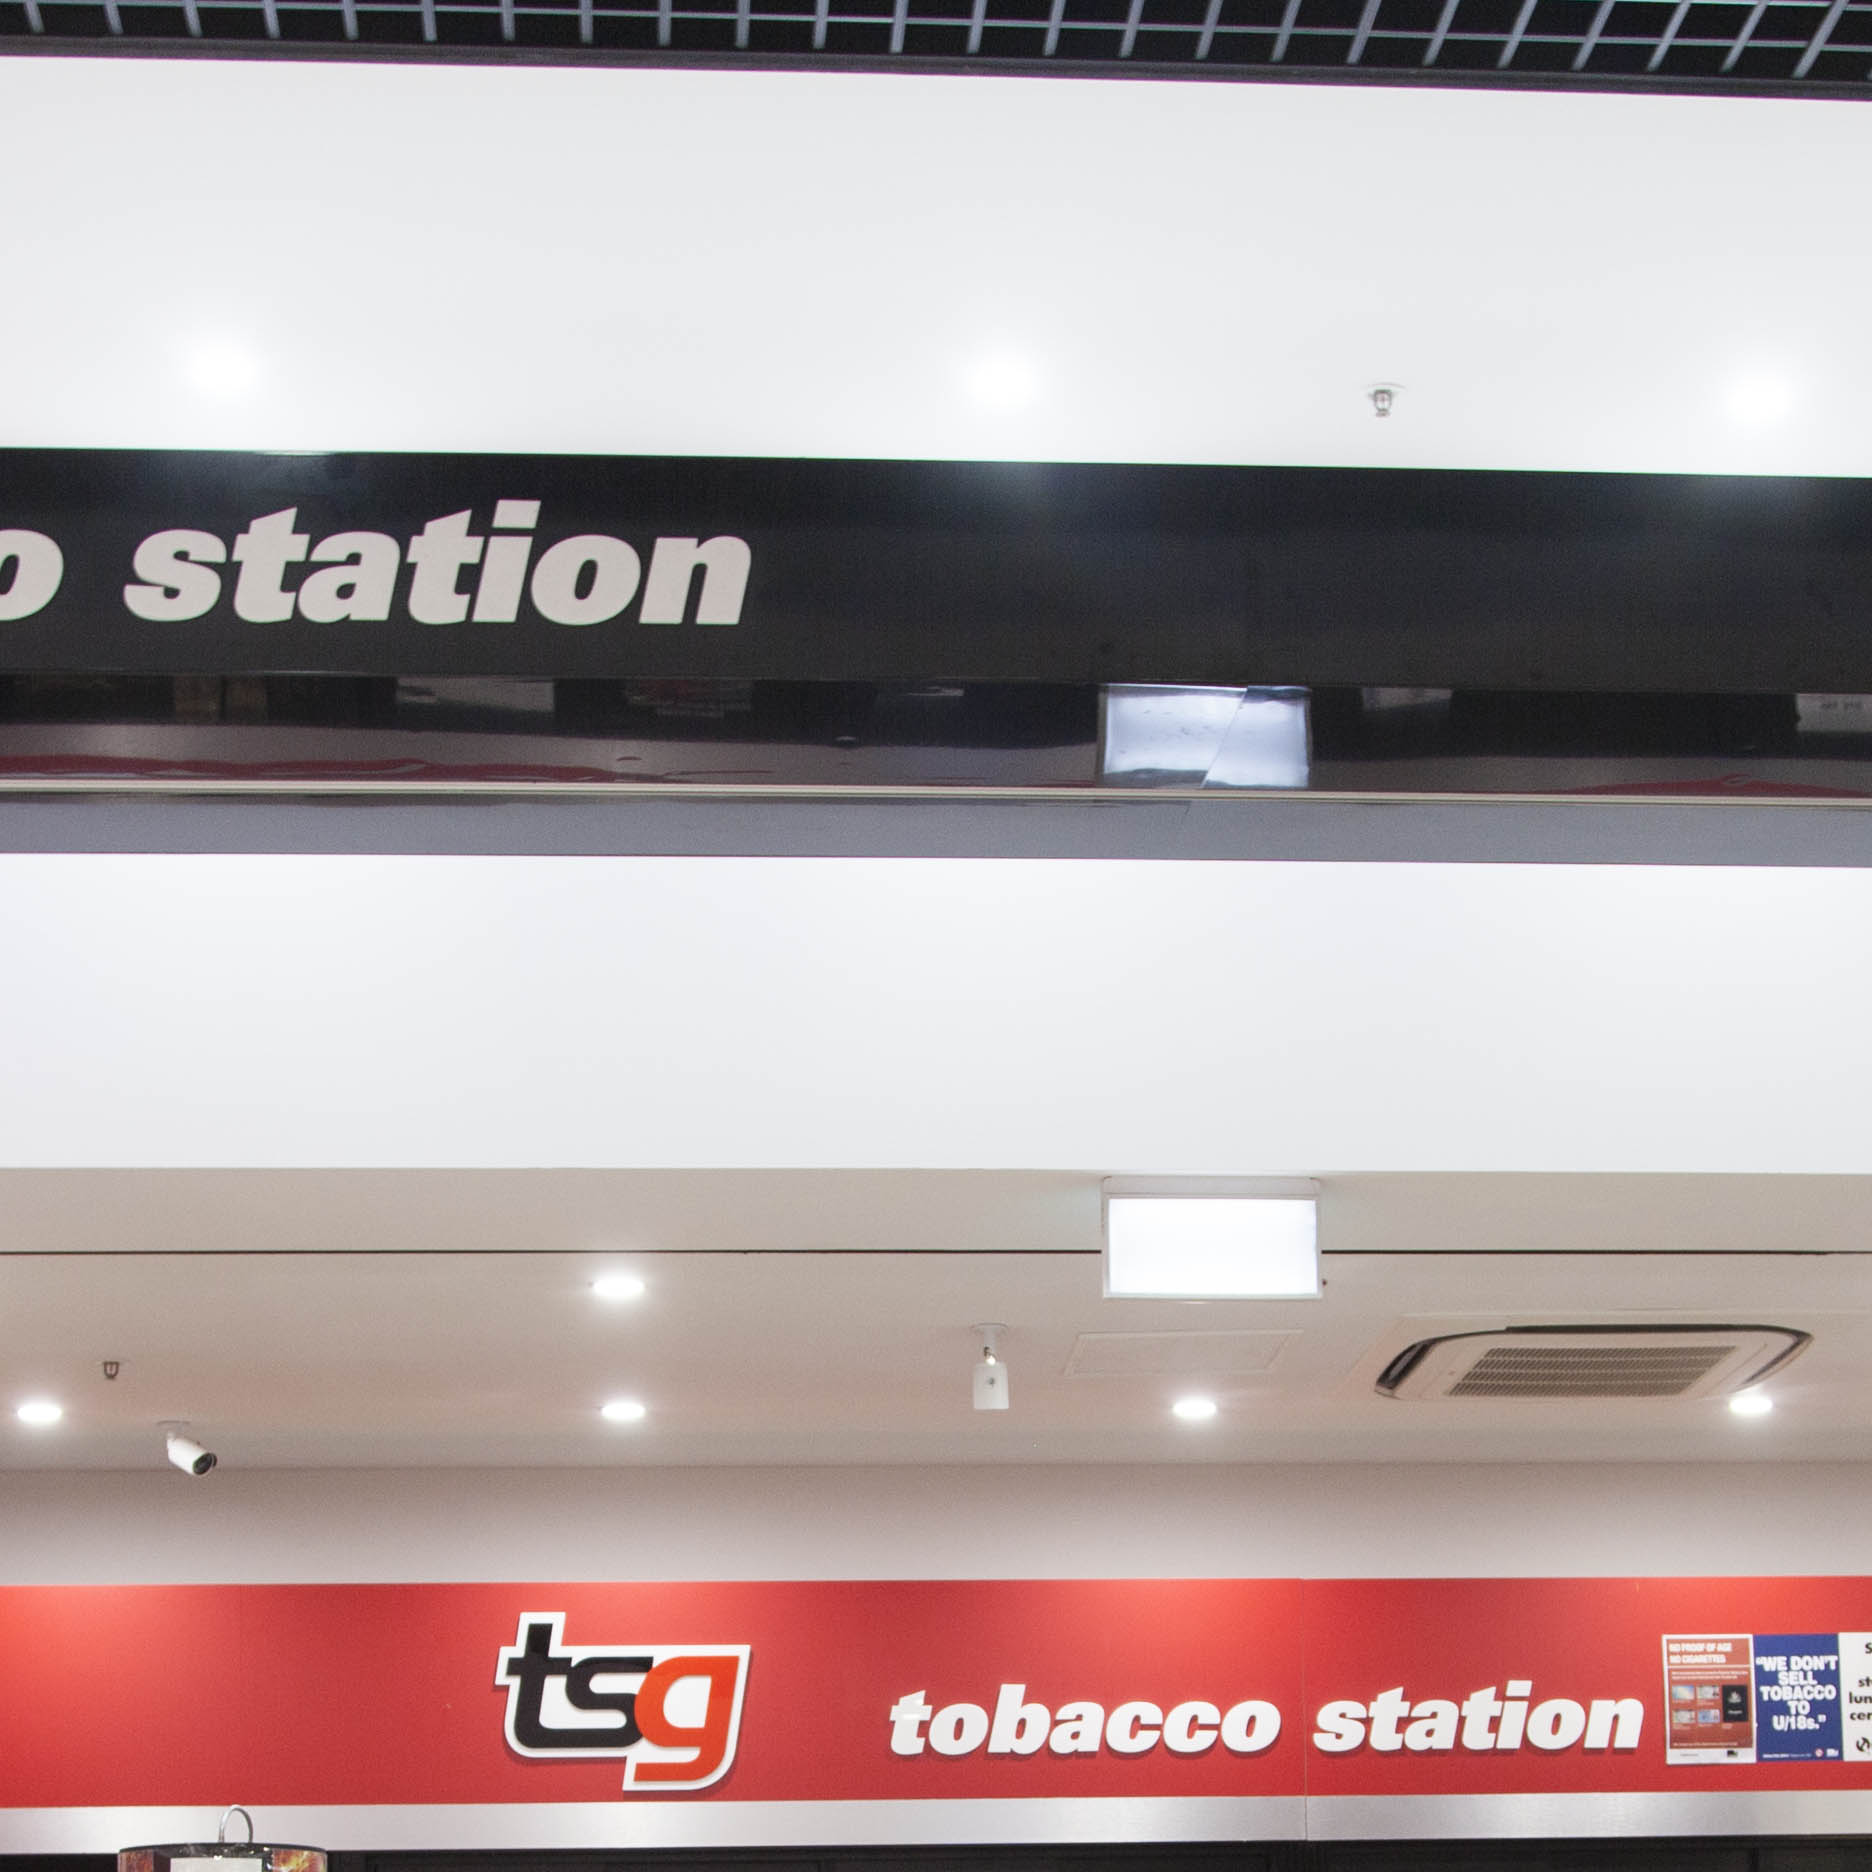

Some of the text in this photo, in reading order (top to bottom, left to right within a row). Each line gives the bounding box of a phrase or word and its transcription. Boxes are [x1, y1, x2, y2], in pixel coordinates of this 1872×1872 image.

[123, 499, 750, 626] station
[1790, 1655, 1838, 1671] DON'T
[1778, 1671, 1818, 1686] SELL
[1760, 1685, 1836, 1700] TOBACCO
[503, 1622, 742, 1782] tsg
[1787, 1701, 1810, 1715] TO
[889, 1680, 1644, 1757] tobacco station
